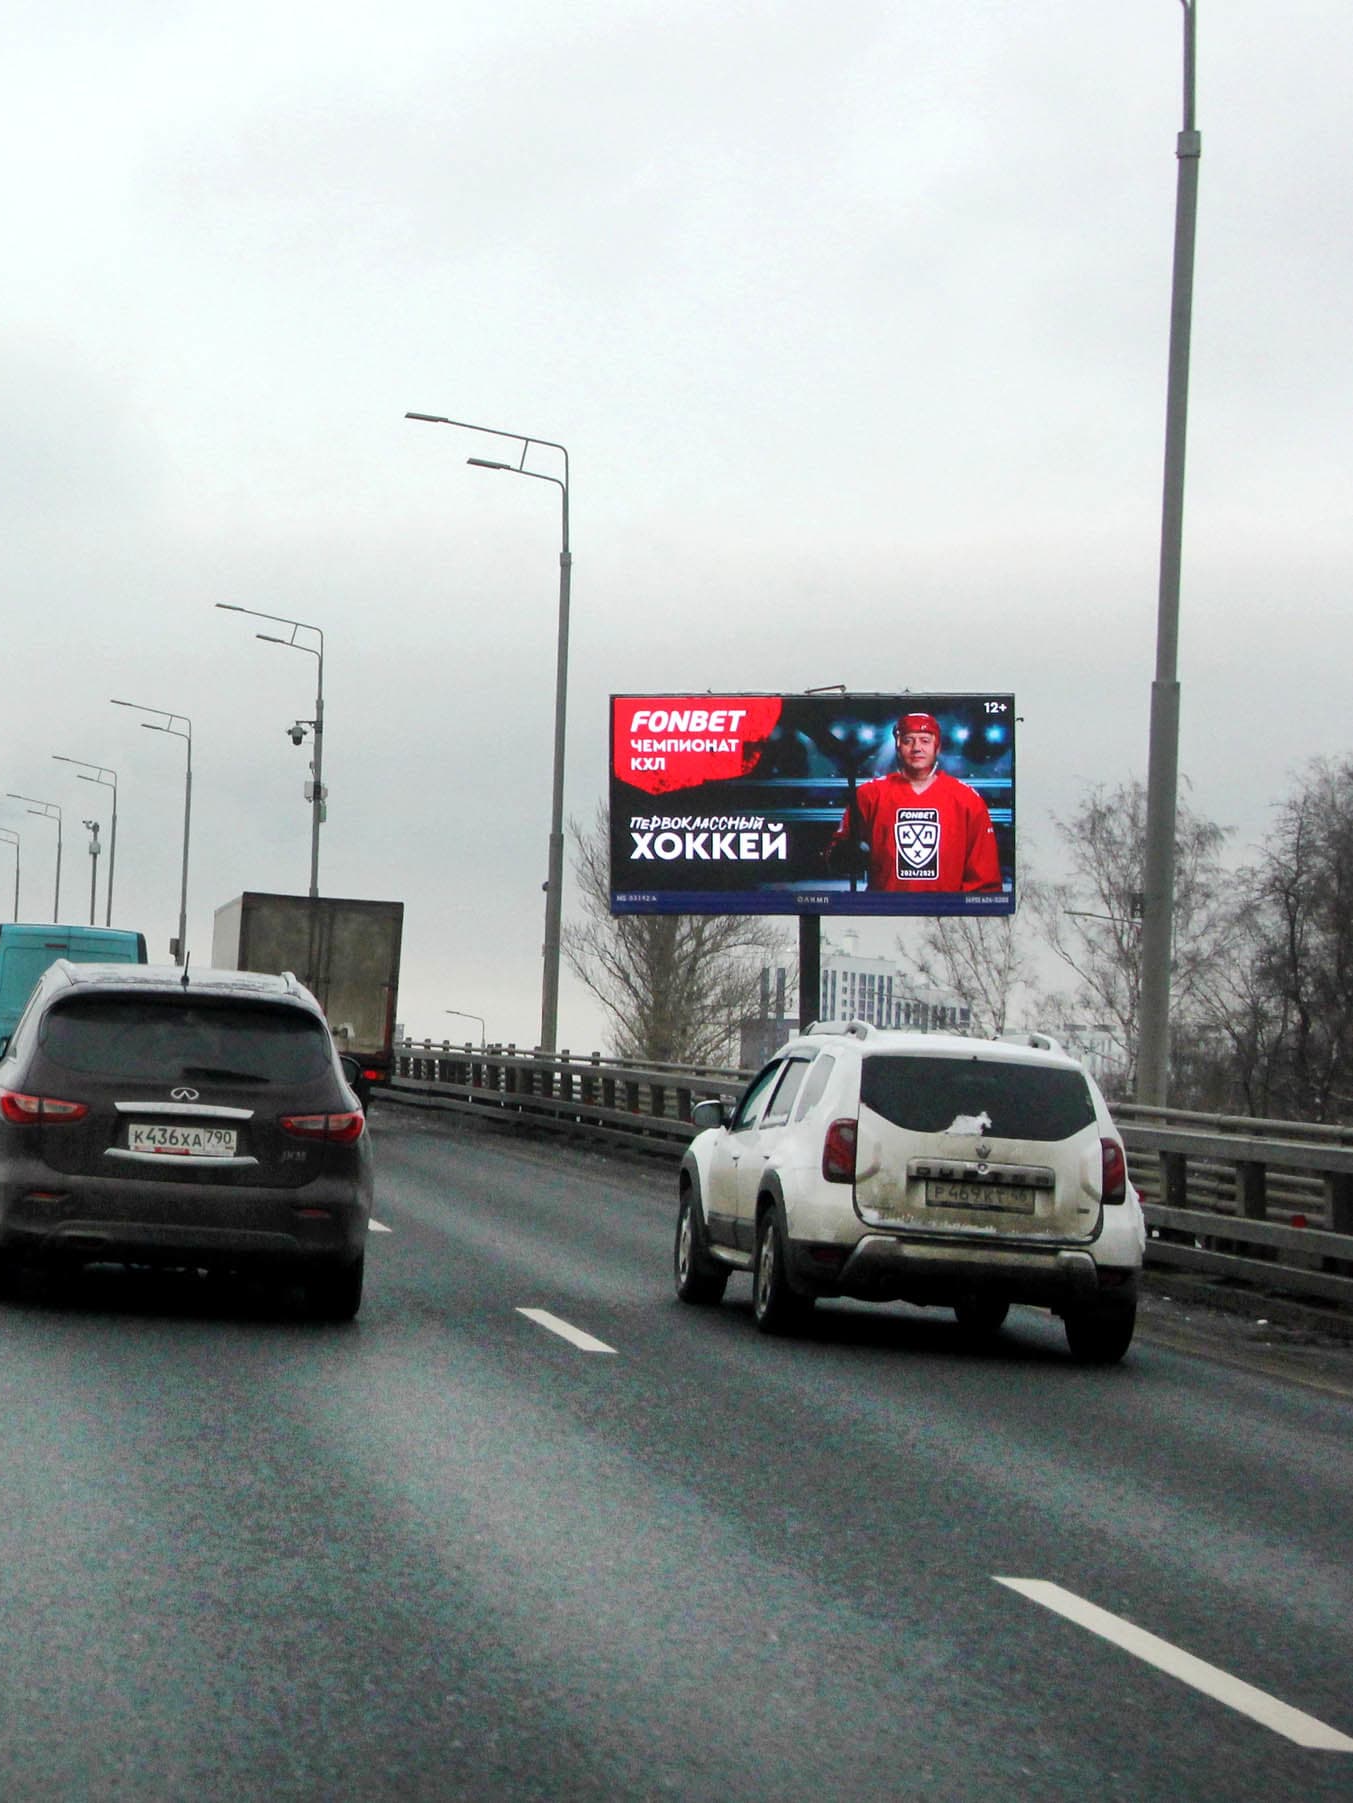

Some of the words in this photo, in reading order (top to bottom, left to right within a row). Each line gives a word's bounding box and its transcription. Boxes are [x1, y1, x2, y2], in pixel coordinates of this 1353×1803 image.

[983, 701, 1008, 713] 12+
[630, 710, 747, 732] FONBET
[630, 739, 739, 752] ЧЕМПИОНАТ
[630, 757, 666, 770] КХЛ
[899, 811, 935, 820] FONBET
[630, 823, 787, 860] ХОККЕЙ
[206, 1130, 232, 1145] 790
